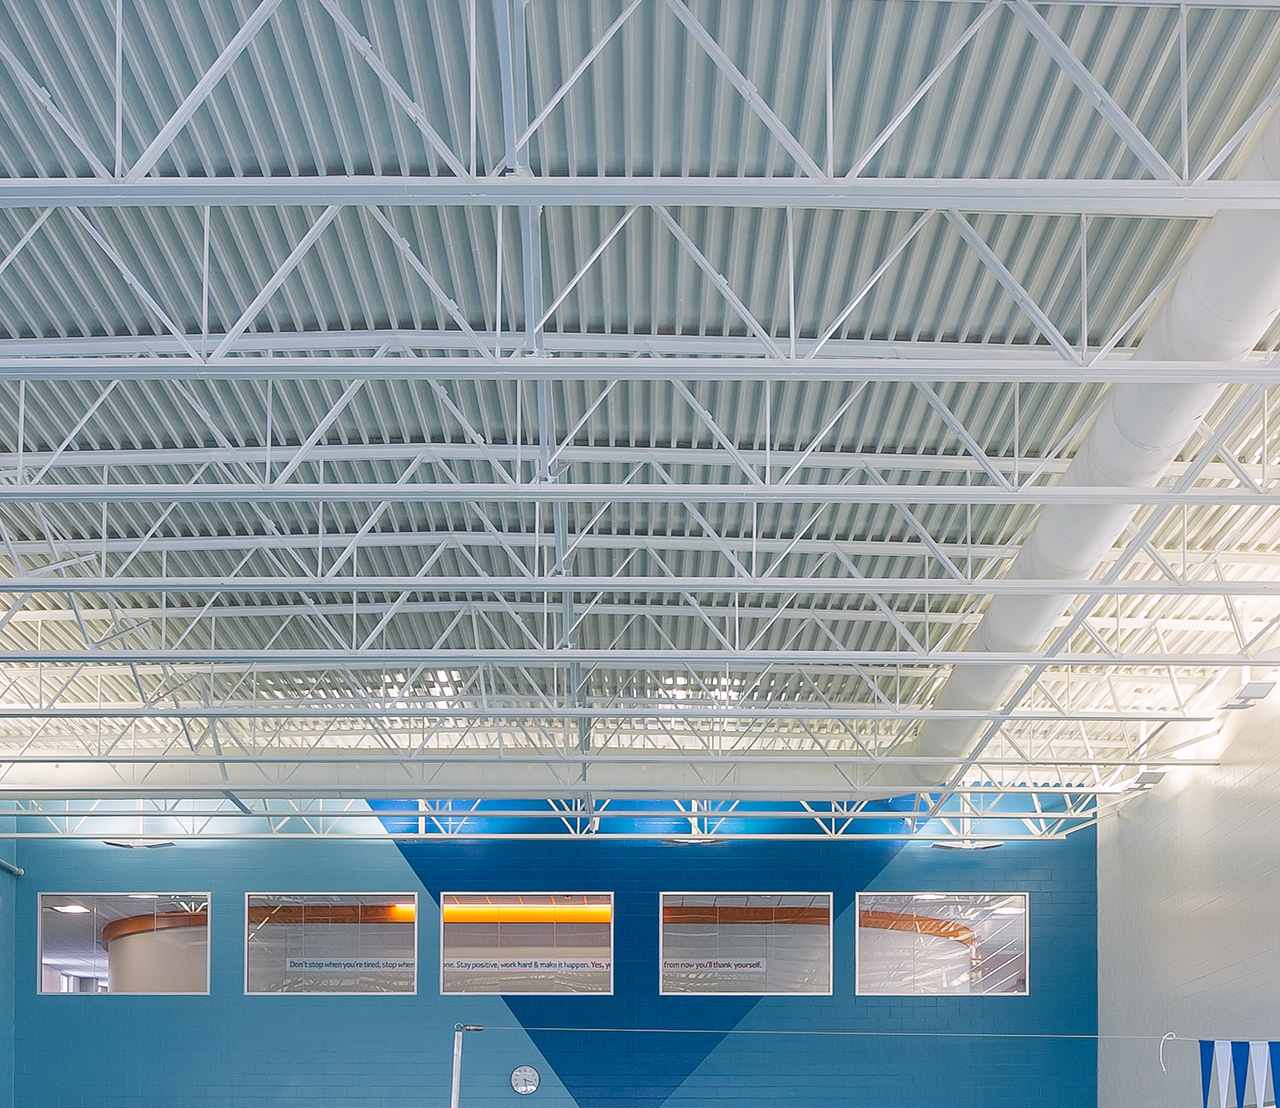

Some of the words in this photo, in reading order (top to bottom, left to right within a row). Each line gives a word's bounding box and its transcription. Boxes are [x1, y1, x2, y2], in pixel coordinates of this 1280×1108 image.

[343, 961, 363, 969] you're
[364, 961, 380, 969] tired,
[456, 961, 470, 969] Stay
[472, 961, 499, 969] positive,
[564, 961, 590, 969] happen.
[591, 961, 604, 969] Yes,
[734, 961, 762, 969] yourself.
